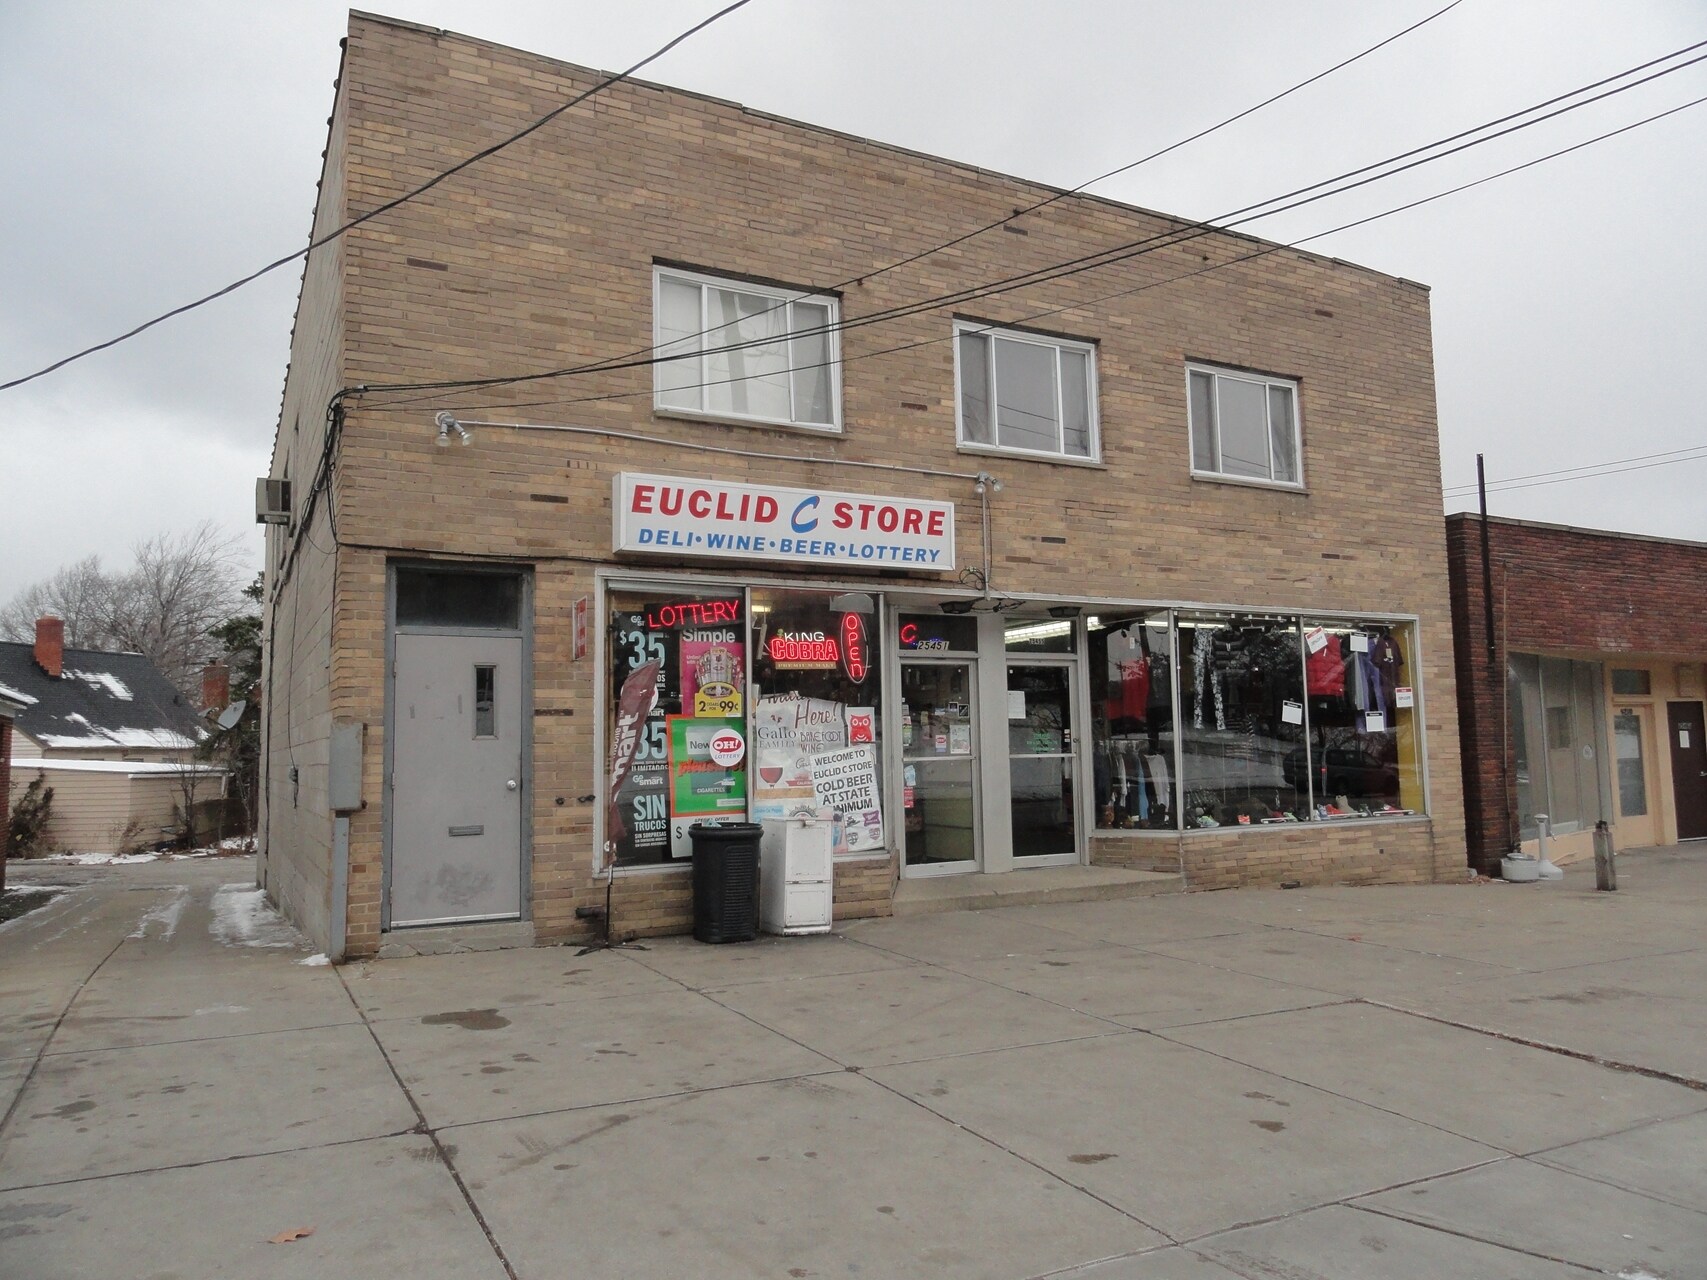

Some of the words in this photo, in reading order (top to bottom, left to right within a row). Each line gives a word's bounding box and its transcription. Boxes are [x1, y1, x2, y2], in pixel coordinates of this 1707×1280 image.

[632, 484, 778, 523] EUCLID
[791, 495, 820, 534] C
[832, 502, 945, 537] STORE
[638, 528, 694, 547] DELI
[707, 533, 765, 552] WINE
[780, 538, 836, 556] BEER
[848, 543, 941, 563] LOTTERY
[648, 600, 739, 628] LOTTERY
[682, 628, 736, 646] Simple
[784, 631, 825, 642] KING
[918, 641, 948, 650] 25451
[771, 638, 838, 660] COBRA
[698, 700, 707, 712] 2
[794, 700, 837, 729] Here!
[757, 726, 797, 740] Gallo
[800, 731, 842, 743] BAREFOOT
[713, 740, 739, 750] OH!
[801, 743, 825, 754] WINE
[814, 751, 854, 766] WELCOME
[854, 749, 866, 759] TO
[813, 767, 841, 780] EUCLID
[842, 765, 848, 774] C
[848, 760, 873, 775] STORE
[816, 779, 845, 794] COLD
[846, 773, 873, 788] BEER
[822, 793, 837, 806] AT
[838, 786, 871, 802] STATE
[633, 793, 666, 821] SIN
[634, 819, 667, 832] TRUCOS
